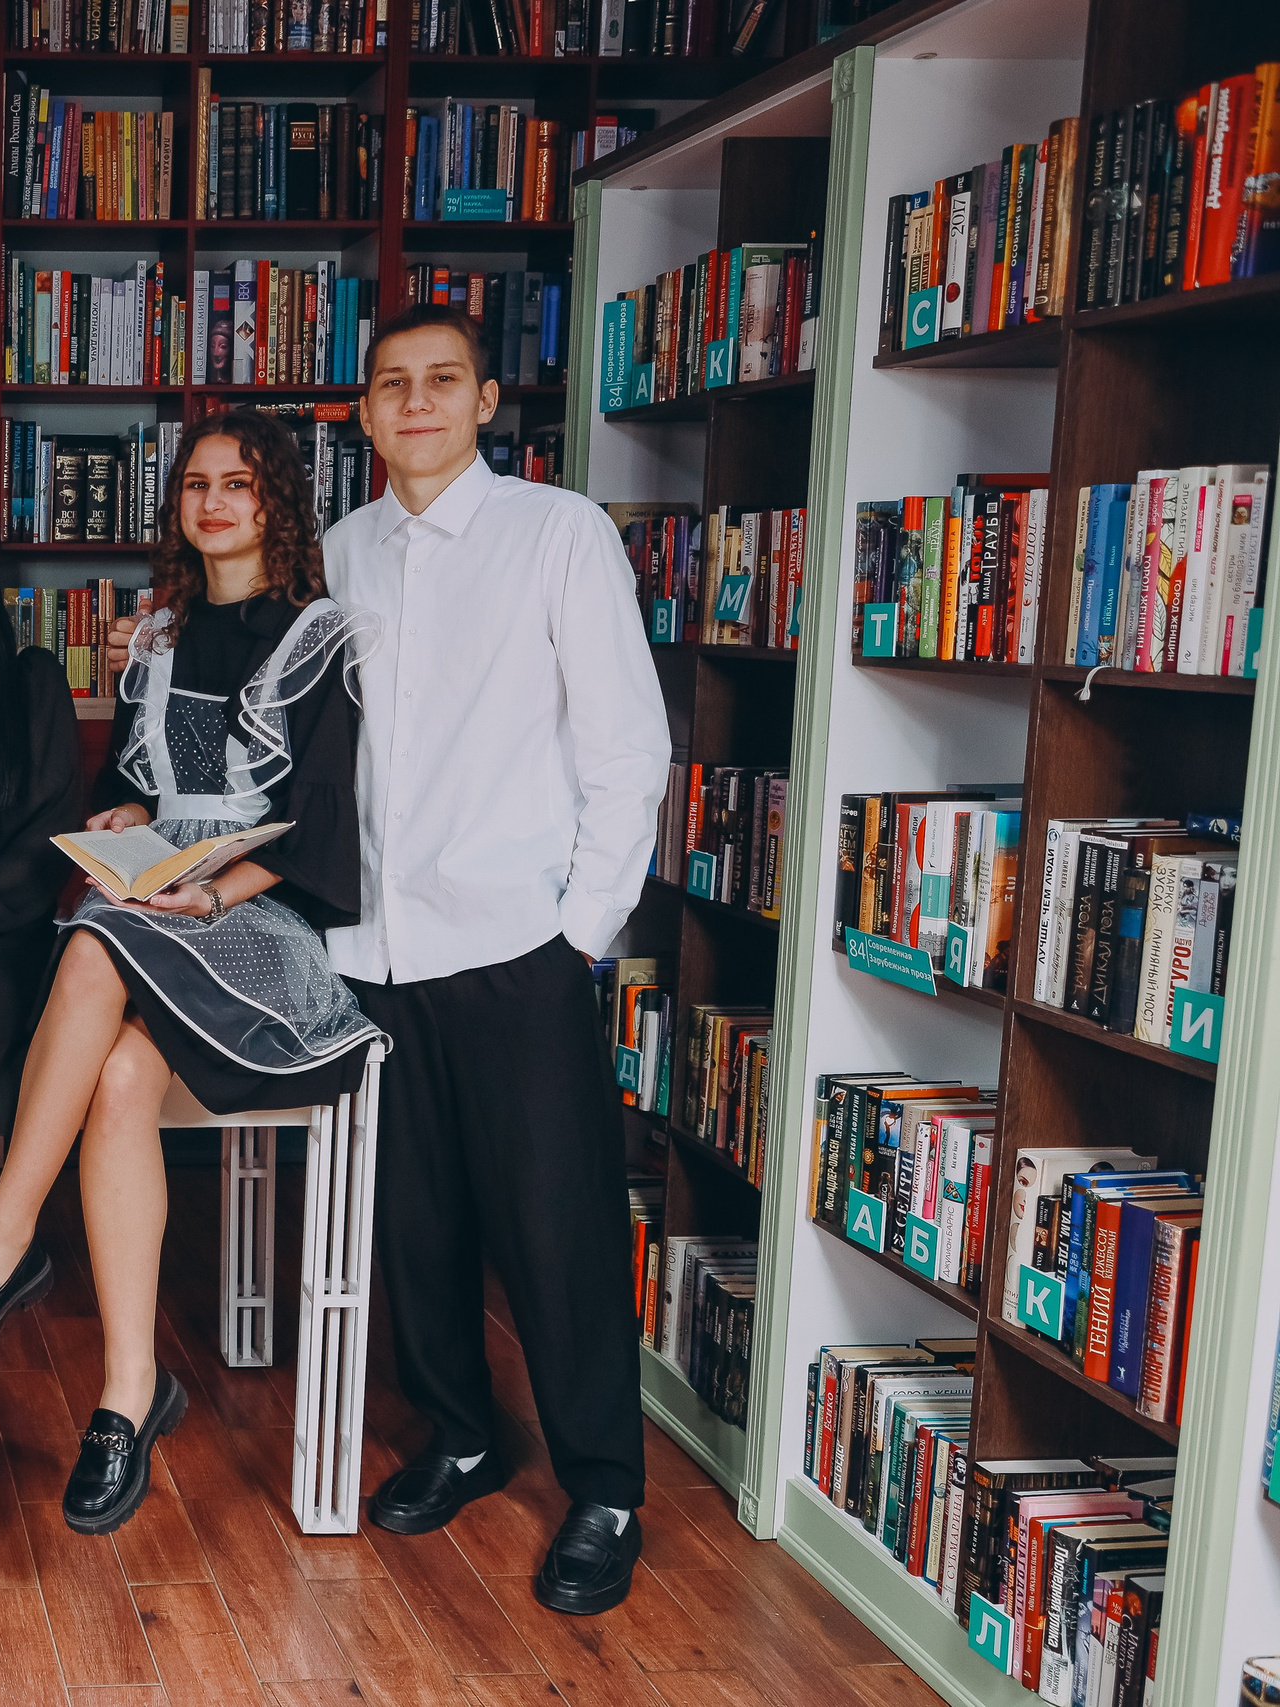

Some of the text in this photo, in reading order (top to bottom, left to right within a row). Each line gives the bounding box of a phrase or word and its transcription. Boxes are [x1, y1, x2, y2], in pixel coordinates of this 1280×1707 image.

[9, 94, 22, 177] Алмазы России-Саха
[1205, 87, 1230, 209] Джон Вердон
[447, 205, 457, 213] 79
[950, 198, 967, 238] 2017
[1011, 162, 1026, 267] ОСОБНЯК В ГОРОДЕ
[1042, 134, 1059, 259] ХРОНИКИ ВТОРОГО ПРИШЕСТВИЯ
[197, 293, 205, 320] МИРА
[238, 282, 250, 300] ВЕК
[1009, 280, 1017, 314] Сергеев
[91, 301, 99, 338] УЮТНАЯ
[196, 322, 204, 354] ТАНКИ
[655, 300, 664, 342] БИЛЕТ
[911, 299, 932, 336] С
[70, 336, 78, 365] АВИАЦИЯ
[606, 322, 615, 383] Современная
[616, 302, 627, 382] Российская проза
[709, 348, 724, 380] К
[608, 386, 623, 408] 84
[635, 372, 649, 400] А
[13, 425, 21, 470] РЫБАЛКА
[26, 425, 34, 470] РЫБАЛКА
[144, 472, 155, 525] КОРАБЛЯХ
[1179, 483, 1190, 536] ЭЛИЗАБЕТ
[744, 519, 754, 556] МАКАНИН
[929, 518, 942, 553] ТРАУБ
[980, 517, 999, 600] МАША ТРАУБ
[1023, 522, 1037, 587] ТОПОЛЬ
[1245, 496, 1263, 585] ФОРРЕСТ ГАМП
[719, 583, 745, 612] М
[945, 530, 956, 623] ТОЙОТА КРЕСТА
[656, 607, 669, 634] В
[958, 592, 968, 654] ТАРКОВСКИЙ
[1083, 578, 1095, 632] Просто люди
[1135, 555, 1152, 649] ГОРОД ЖЕНЩИН
[1167, 579, 1182, 662] ГОРОД ЖЕНЩИН
[871, 613, 888, 646] Т
[686, 801, 698, 855] ОХЛОБЫСТИН
[692, 859, 708, 890] П
[766, 837, 777, 907] ВИКТОР ПЕЛЕВИН
[1082, 845, 1092, 888] ДЖЕННИФЕР
[1089, 848, 1098, 887] ДОННЕЛЛИ
[1103, 849, 1114, 893] ДЖЕННИФЕР
[1110, 853, 1120, 892] ДОННЕЛЛИ
[1152, 867, 1166, 912] ЗУСАК
[1038, 848, 1055, 964] ЛУЧШЕ, ЧЕМ ЛЮДИ
[1163, 868, 1176, 913] МАРКУС
[849, 938, 913, 961] 84 Современная
[868, 955, 933, 982] Зарубежная проза
[948, 937, 963, 974] Я
[1091, 899, 1115, 1005] ДИКАЯ РОЗА
[1143, 928, 1163, 1026] ГЛИНЯНЫЙ МОСТ
[1180, 1001, 1215, 1050] И
[619, 1052, 637, 1083] Д
[828, 1114, 836, 1129] БЕЗ
[835, 1106, 844, 1140] ПРЕДЕЛА
[849, 1094, 860, 1161] СУХБАТ АФЛАТУНИ
[824, 1138, 840, 1211] Юсси АДЛЕР-ОЛЬСЕН
[911, 1140, 924, 1194] Веснушка
[894, 1156, 914, 1228] СЕЛФИ
[971, 1164, 983, 1229] УЛЫБКА ЖЕНЩИНЫ
[852, 1204, 876, 1241] А
[909, 1226, 930, 1264] Б
[943, 1206, 955, 1279] Джулиан БАРНС
[1058, 1209, 1072, 1268] ТАМ, ГДЕ
[1094, 1227, 1108, 1278] ДЖЕССИ
[1105, 1230, 1117, 1280] КЕЛЛЕРМАН
[1024, 1279, 1052, 1325] К
[1088, 1284, 1112, 1357] ГЕНИЙ
[914, 1438, 926, 1501] ДОМ АНГЕЛОВ
[946, 1493, 963, 1580] СУБМАРИНА
[1047, 1545, 1069, 1648] Последняя улика
[975, 1611, 1002, 1658] Л
